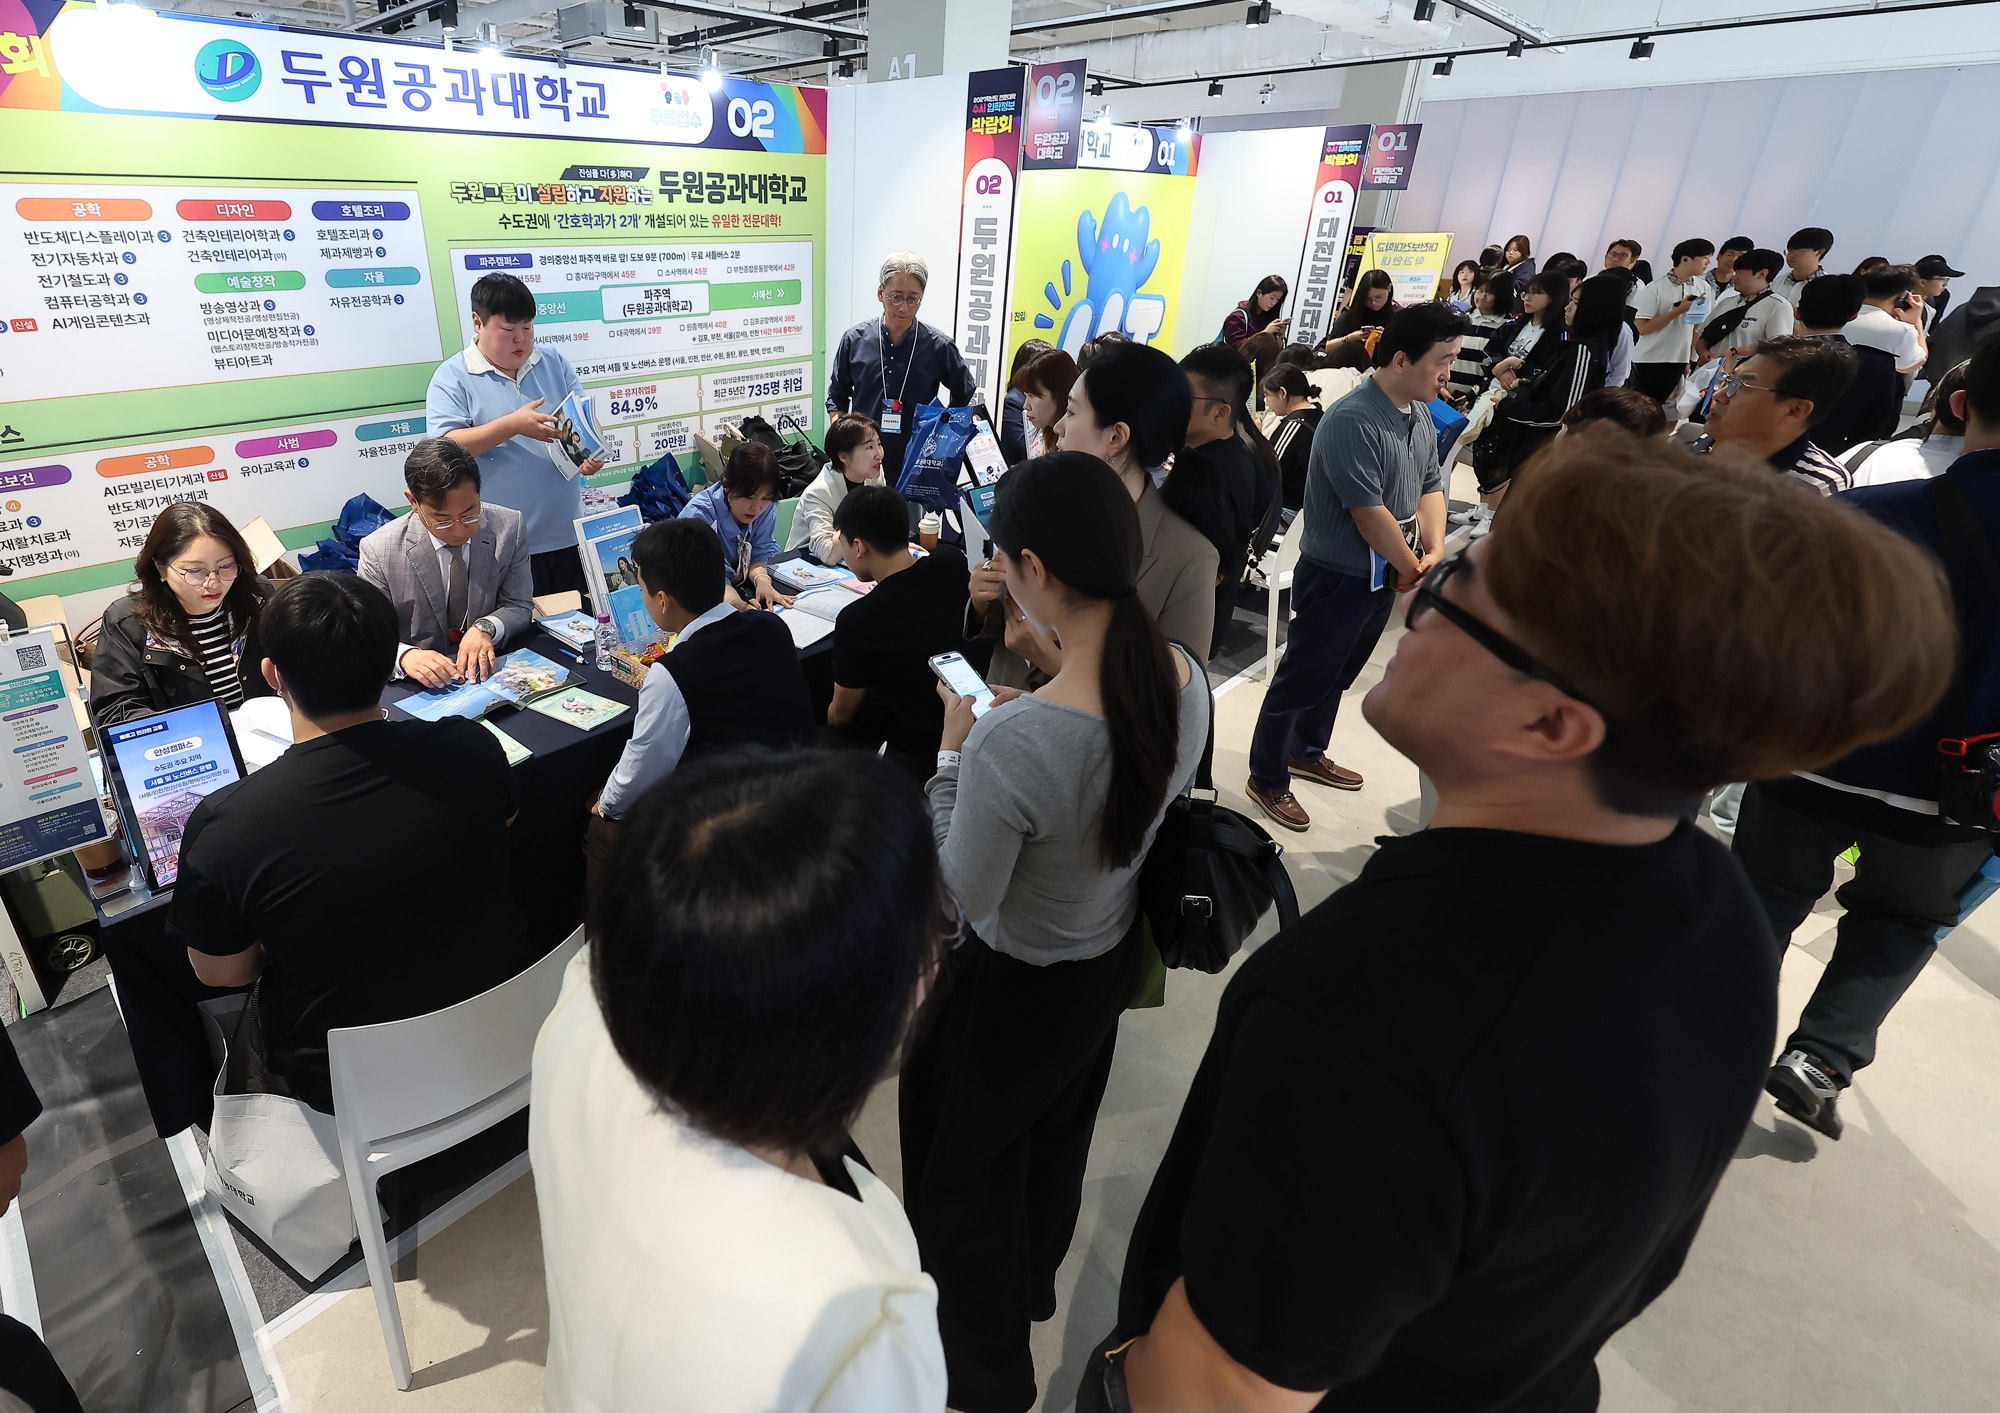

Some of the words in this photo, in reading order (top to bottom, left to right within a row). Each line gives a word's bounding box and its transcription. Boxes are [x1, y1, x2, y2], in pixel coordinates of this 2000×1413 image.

[888, 53, 916, 80] A1
[281, 50, 610, 122] 두원공과대학교
[1036, 72, 1076, 106] 02
[972, 103, 986, 114] 수시
[987, 101, 1016, 113] 입학정보
[727, 97, 776, 139] 02
[972, 114, 1013, 135] 박람회
[1034, 132, 1069, 146] 두원공과
[1378, 132, 1408, 151] 01
[1036, 146, 1064, 160] 대학교
[1157, 140, 1176, 166] 01
[1324, 153, 1359, 166] 박람회
[578, 168, 599, 178] 진심을
[1372, 166, 1404, 176] 대전보건
[976, 175, 1001, 195] 02
[1373, 175, 1398, 184] 대학교
[450, 181, 533, 204] 두원그룹이
[536, 183, 597, 205] 설립하고
[598, 185, 654, 206] 지원하는
[659, 170, 808, 205] 두원공과대학교
[1324, 191, 1343, 203] 01
[71, 202, 102, 218] 공학
[216, 204, 256, 218] 디자인
[341, 204, 385, 218] 호텔조리
[498, 213, 551, 230] 수도권에
[645, 214, 686, 229] 개설되어
[689, 214, 709, 229] 있는
[711, 214, 740, 229] 유일한
[742, 213, 782, 228] 전문대학!
[23, 230, 154, 245] 반도체디스플레이과
[182, 229, 280, 243] 건축인테리어학과
[316, 229, 370, 242] 호텔조리과
[31, 251, 119, 267] 전기자동차과
[320, 246, 373, 260] 제과제빵과
[539, 254, 578, 266] 경의중앙선
[579, 253, 601, 264] 파주역
[602, 252, 617, 262] 바로
[630, 252, 644, 262] 도보
[645, 252, 658, 262] 9분
[659, 252, 686, 263] (700m)
[691, 251, 704, 260] 무료
[705, 250, 729, 260] 셔틀버스
[730, 250, 741, 260] 2분
[478, 256, 521, 267] 파주캠퍼스
[783, 264, 796, 272] 42분
[363, 271, 386, 284] 자율
[524, 275, 542, 283] 55분
[574, 271, 620, 281] 홍대입구역에서
[621, 270, 636, 279] 45분
[664, 268, 694, 276] 소사역에서
[694, 267, 708, 275] 45분
[37, 273, 111, 289] 전기철도과
[226, 274, 276, 290] 예술창작
[44, 293, 130, 310] 컴퓨터공학과
[329, 294, 392, 309] 자유전공학과
[644, 288, 671, 301] 파주역
[752, 289, 773, 300] 서해선
[200, 299, 261, 315] 방송영상과
[534, 302, 567, 316] 중앙선
[622, 300, 693, 317] (두원공과대학교)
[14, 320, 35, 330] 신설
[52, 312, 150, 330] AI게임콘텐츠과
[714, 320, 728, 329] 40분
[207, 325, 301, 343] 미디어문예창작과
[573, 332, 589, 342] 39분
[617, 326, 647, 337] 대곡역에서
[648, 325, 662, 335] 29분
[214, 353, 273, 371] 뷰티아트과
[575, 366, 590, 376] 주요
[591, 363, 606, 374] 지역
[607, 361, 621, 372] 셔틀
[622, 360, 630, 371] 및
[630, 358, 657, 369] 노선버스
[657, 356, 671, 366] 운행
[609, 389, 624, 399] 높은
[624, 385, 657, 397] 유지취업률
[713, 388, 727, 398] 최근
[728, 385, 746, 396] 5년간
[747, 379, 781, 398] 735명
[783, 376, 803, 393] 취업
[610, 395, 658, 416] 84.9%
[390, 422, 411, 434] 자율
[277, 437, 300, 450] 사범
[358, 441, 415, 459] 자율전공학과
[654, 434, 687, 451] 20만원
[144, 454, 170, 469] 공학
[240, 459, 295, 477] 유아교육과
[103, 472, 205, 498] AI모빌리티기계과
[107, 490, 209, 516] 반도체기계설계과
[118, 534, 149, 548] 자동
[153, 741, 194, 757] 안성캠퍼스
[153, 762, 174, 772] 수도권
[174, 759, 188, 767] 주요
[188, 754, 202, 763] 지역
[150, 779, 164, 787] 셔틀
[173, 769, 199, 780] 노선버스
